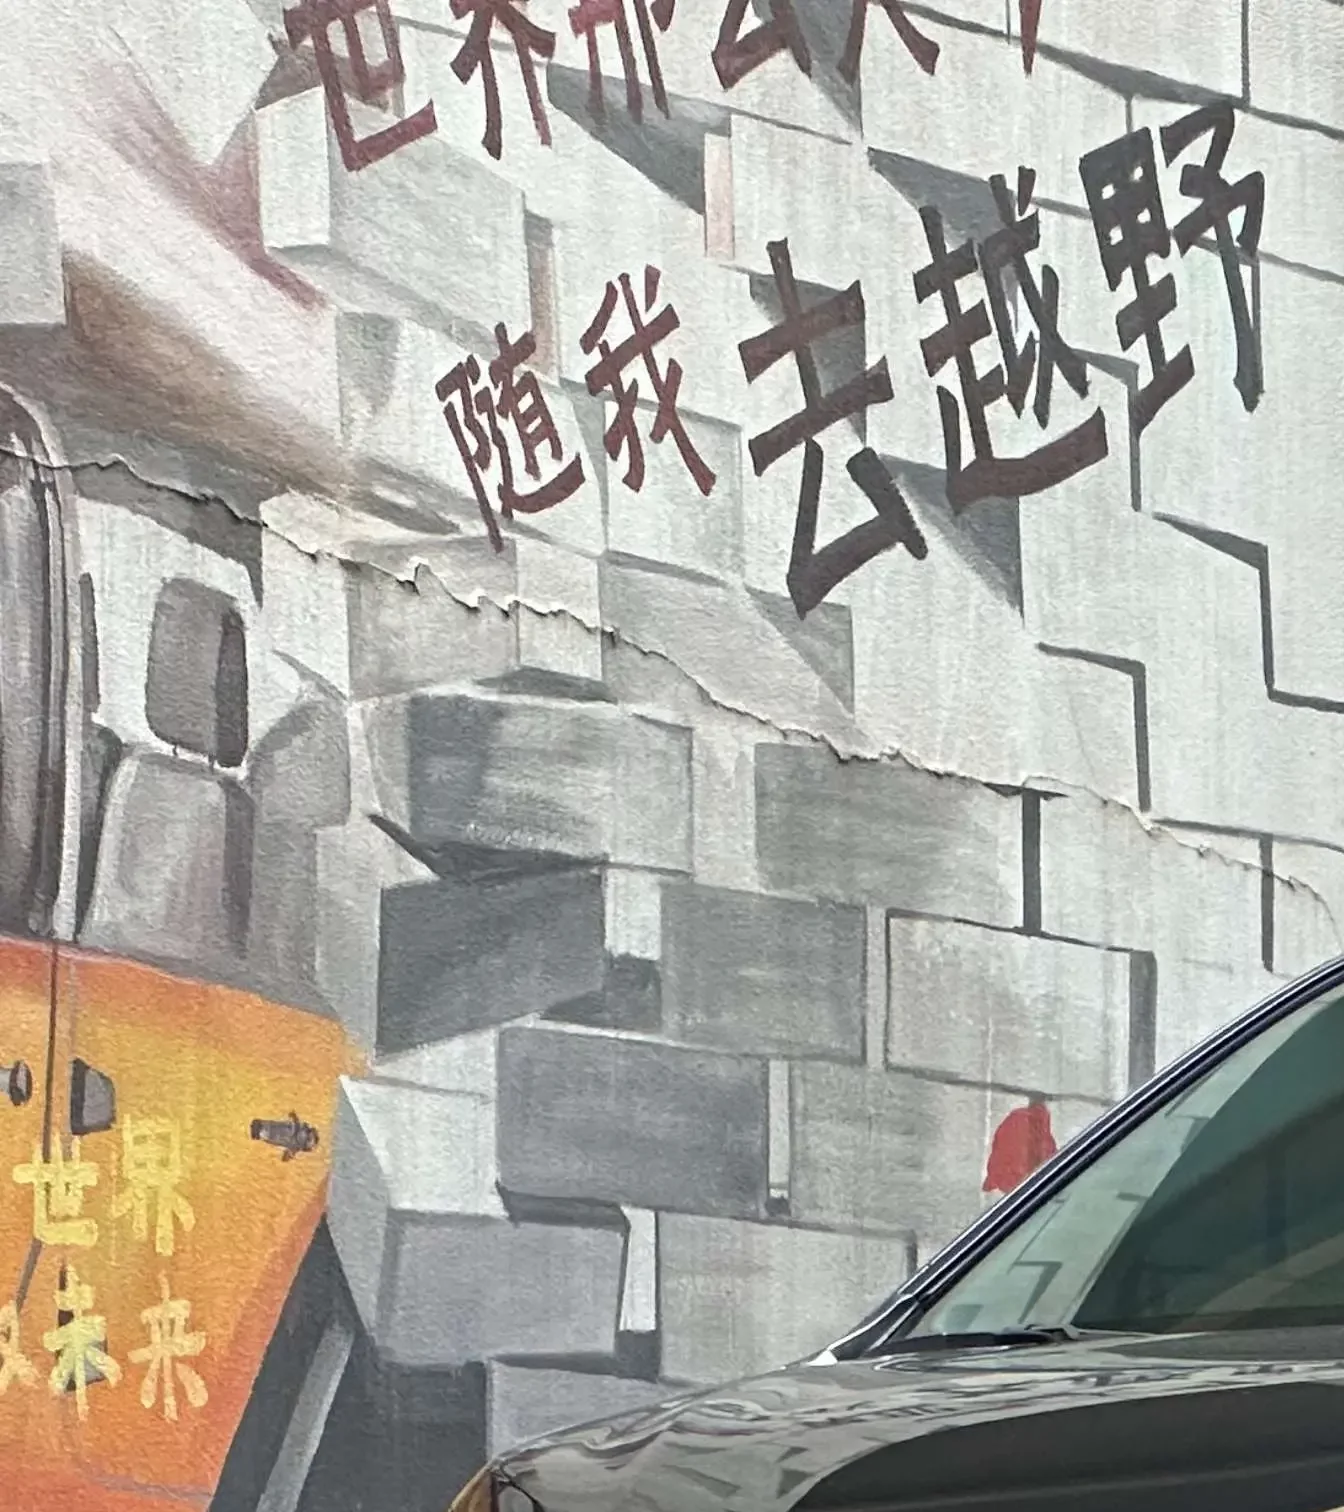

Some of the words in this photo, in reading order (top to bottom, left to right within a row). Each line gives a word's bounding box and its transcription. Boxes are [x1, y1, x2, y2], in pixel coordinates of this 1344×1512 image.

[436, 106, 1267, 617] 随我去越野
[13, 1112, 196, 1257] 世界
